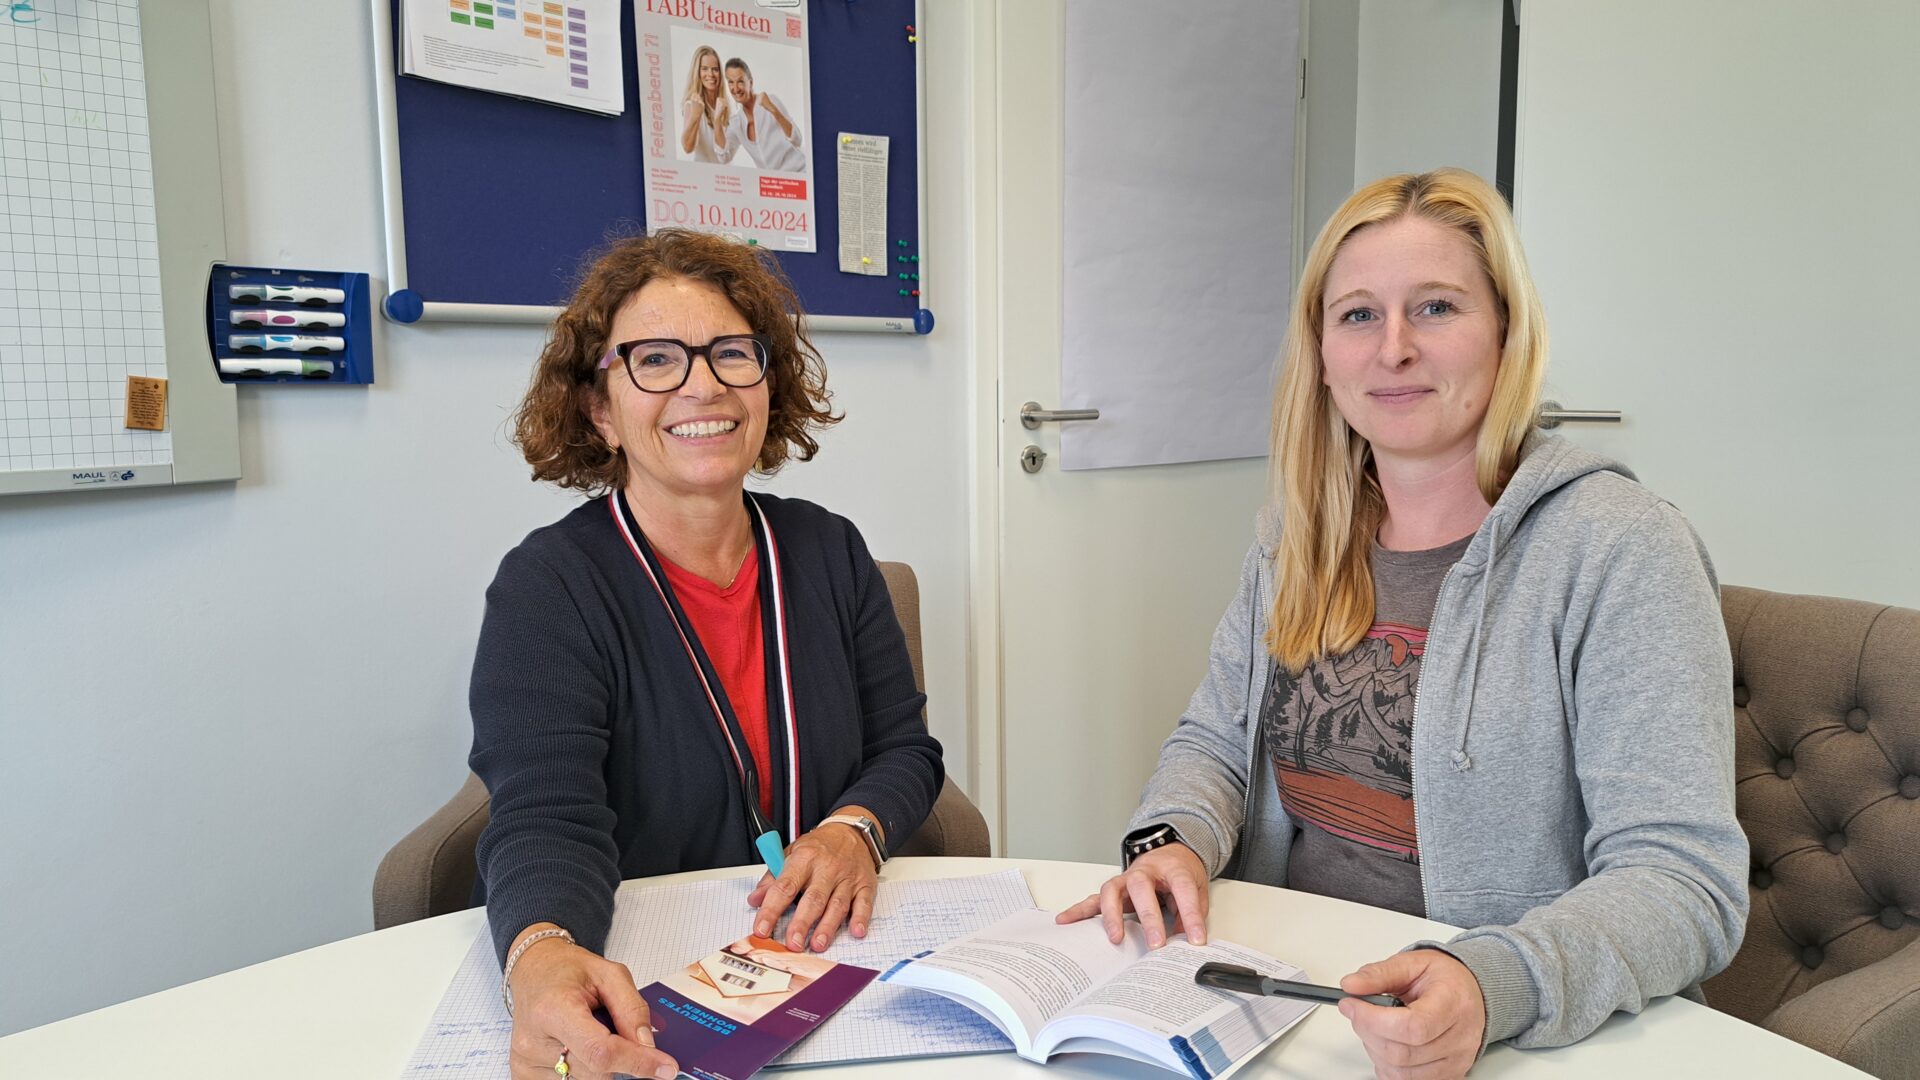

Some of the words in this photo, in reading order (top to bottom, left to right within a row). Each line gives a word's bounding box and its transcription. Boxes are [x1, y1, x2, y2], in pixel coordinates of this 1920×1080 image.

[654, 199, 695, 224] DO.
[700, 204, 808, 232] 10.10.2024
[73, 472, 105, 480] MAUL
[658, 997, 731, 1035] BETREUTES
[682, 1003, 737, 1031] WOHNEN
